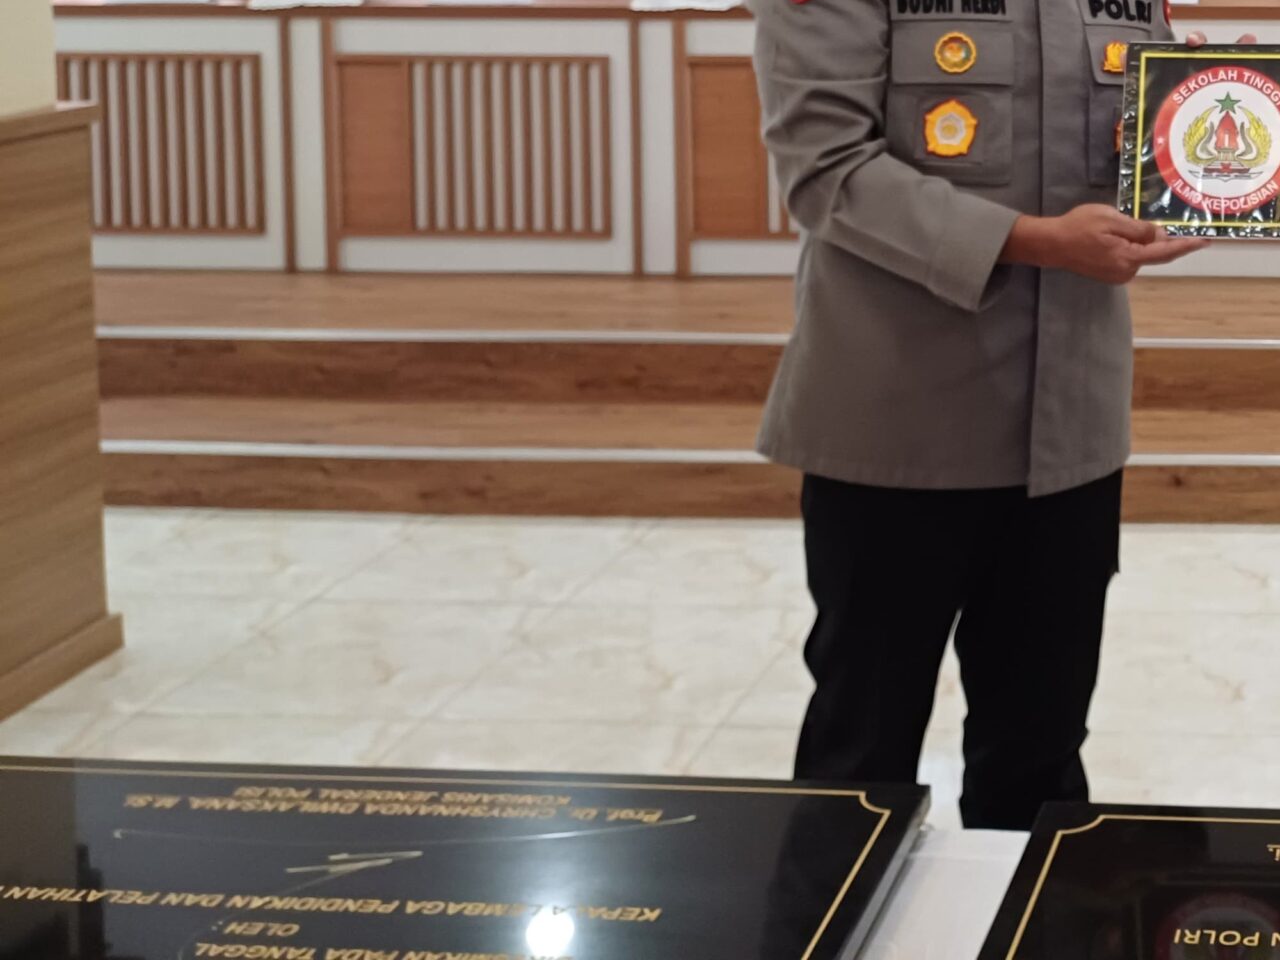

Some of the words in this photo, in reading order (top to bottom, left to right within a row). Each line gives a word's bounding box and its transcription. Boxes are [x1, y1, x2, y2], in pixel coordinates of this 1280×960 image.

[1172, 70, 1238, 106] SEKOLAH
[1202, 180, 1280, 211] KEPOLISIAN
[4, 886, 161, 905] PELATIHAN
[159, 892, 226, 908] DAN
[224, 895, 400, 914] PENDIDIKAN
[223, 922, 300, 937] OLEH
[1173, 929, 1260, 947] POLRI
[194, 943, 317, 960] TANGGAL
